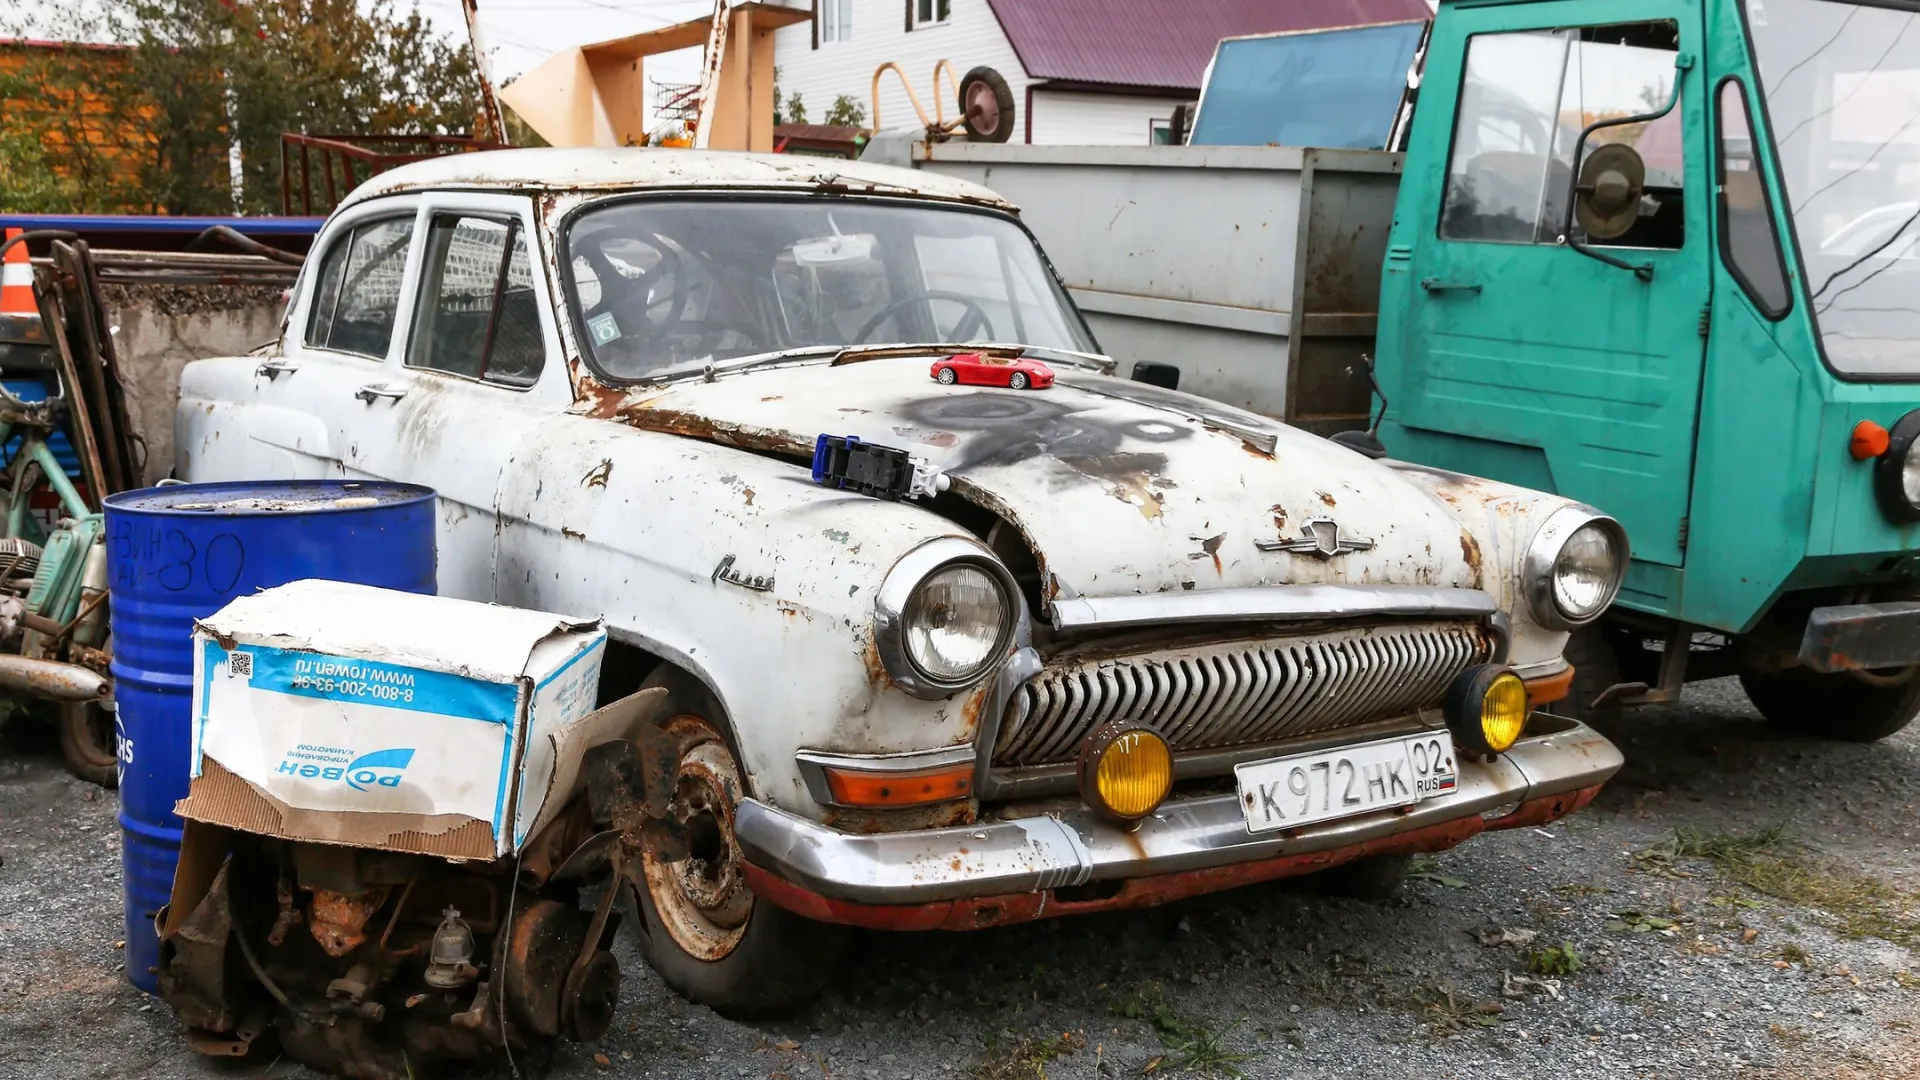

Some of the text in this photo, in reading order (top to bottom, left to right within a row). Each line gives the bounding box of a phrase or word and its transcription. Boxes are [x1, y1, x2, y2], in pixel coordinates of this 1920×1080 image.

[295, 659, 415, 687] www.rowen.ru
[1413, 739, 1446, 777] 02
[1417, 776, 1438, 793] RUS
